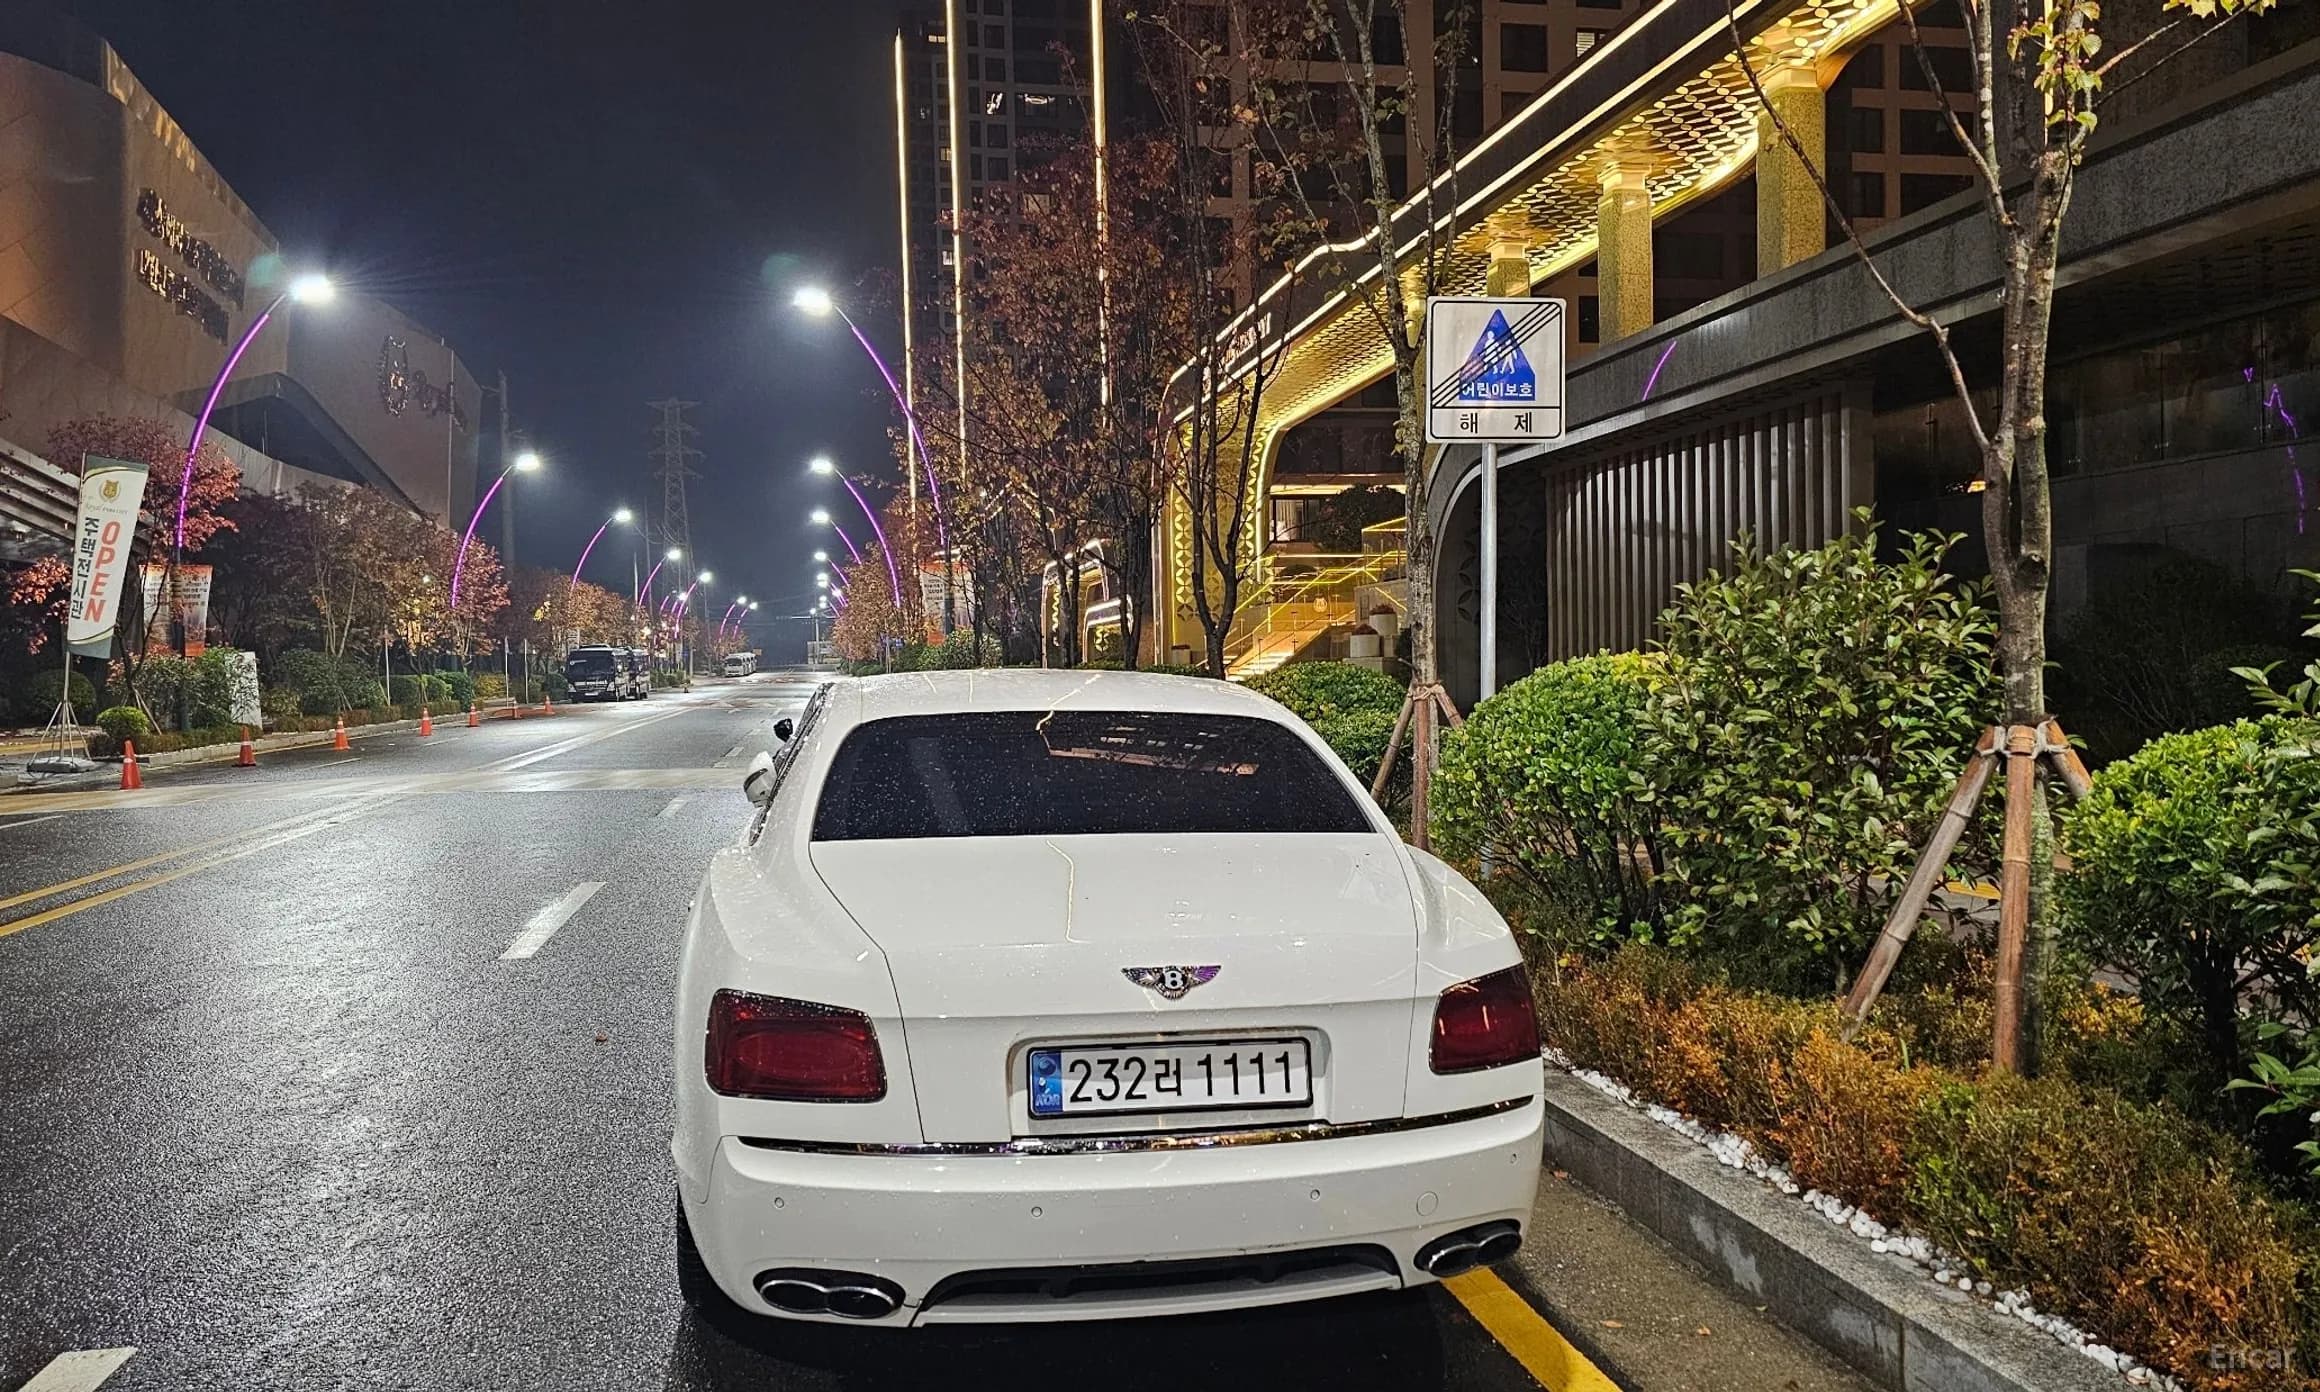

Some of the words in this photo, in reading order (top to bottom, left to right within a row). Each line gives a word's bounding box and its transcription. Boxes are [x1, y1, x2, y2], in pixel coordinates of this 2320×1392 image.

[1462, 382, 1533, 398] 어린이보호
[71, 517, 100, 620] 주택전시관
[84, 521, 121, 623] OPEN
[1164, 970, 1184, 989] B
[1069, 1057, 1182, 1103] 232러
[1197, 1051, 1291, 1097] 1111
